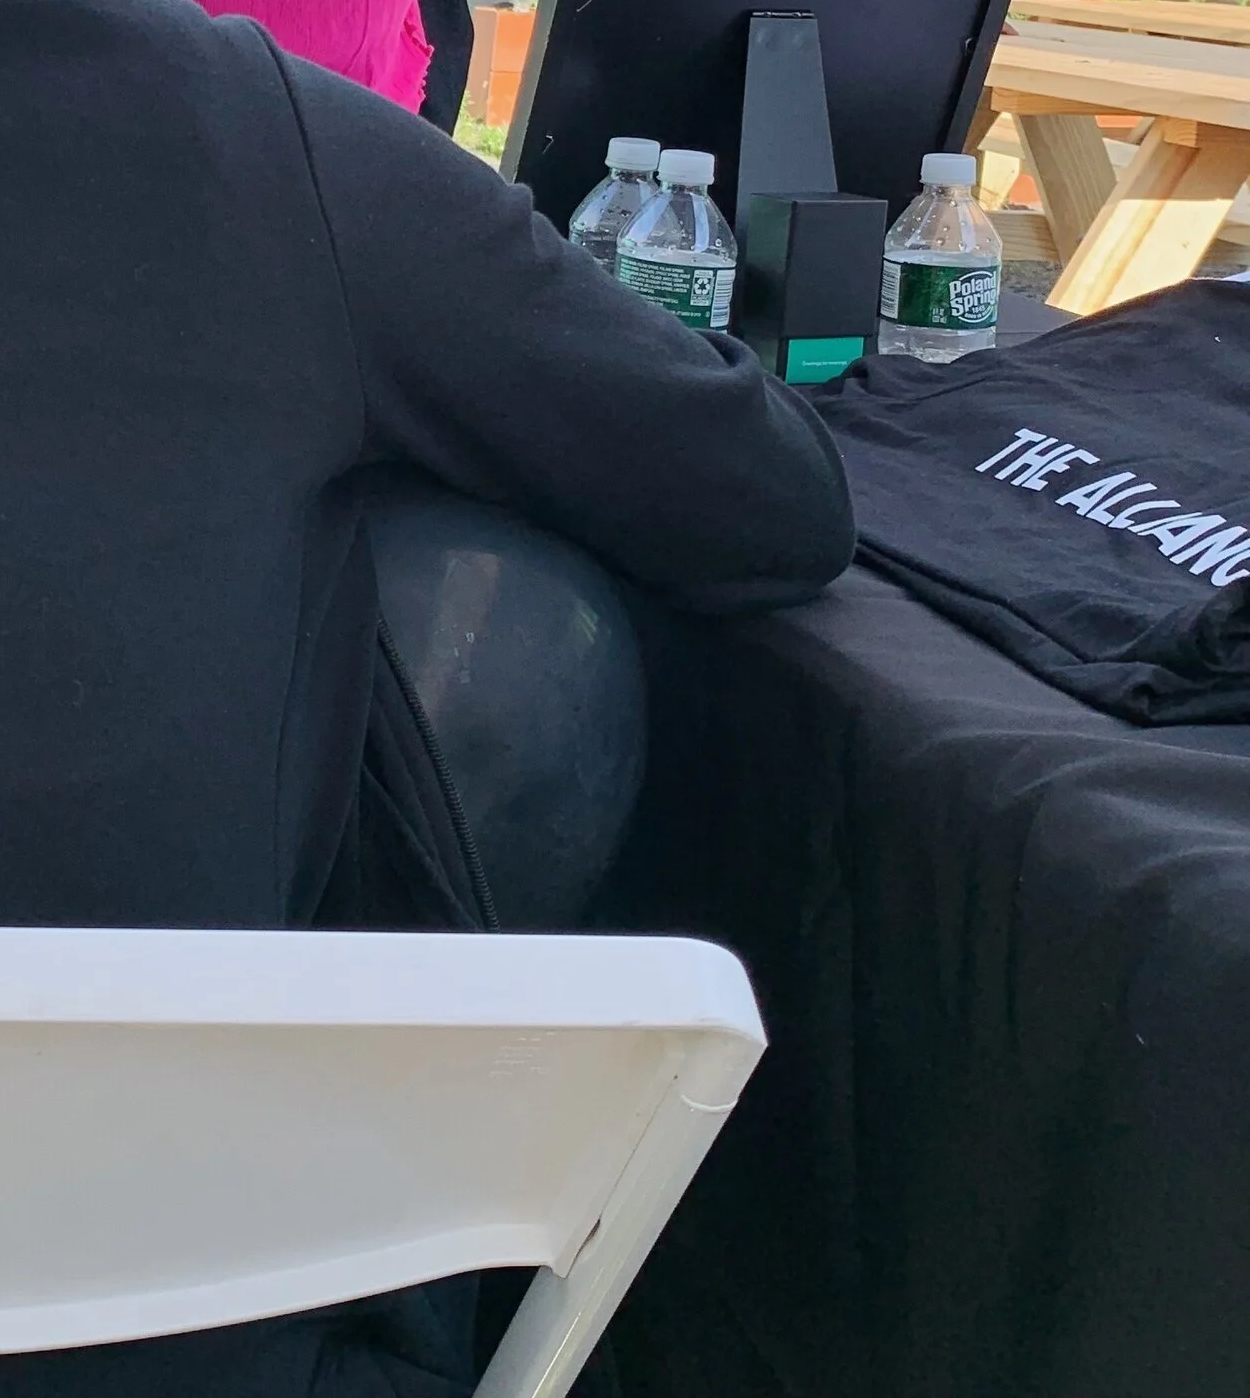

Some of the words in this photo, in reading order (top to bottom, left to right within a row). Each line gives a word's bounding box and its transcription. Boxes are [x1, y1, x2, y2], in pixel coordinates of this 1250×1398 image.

[949, 271, 997, 301] Poland
[950, 288, 997, 317] Spring
[975, 428, 1100, 491] THE
[1055, 471, 1250, 587] ALLIANC
